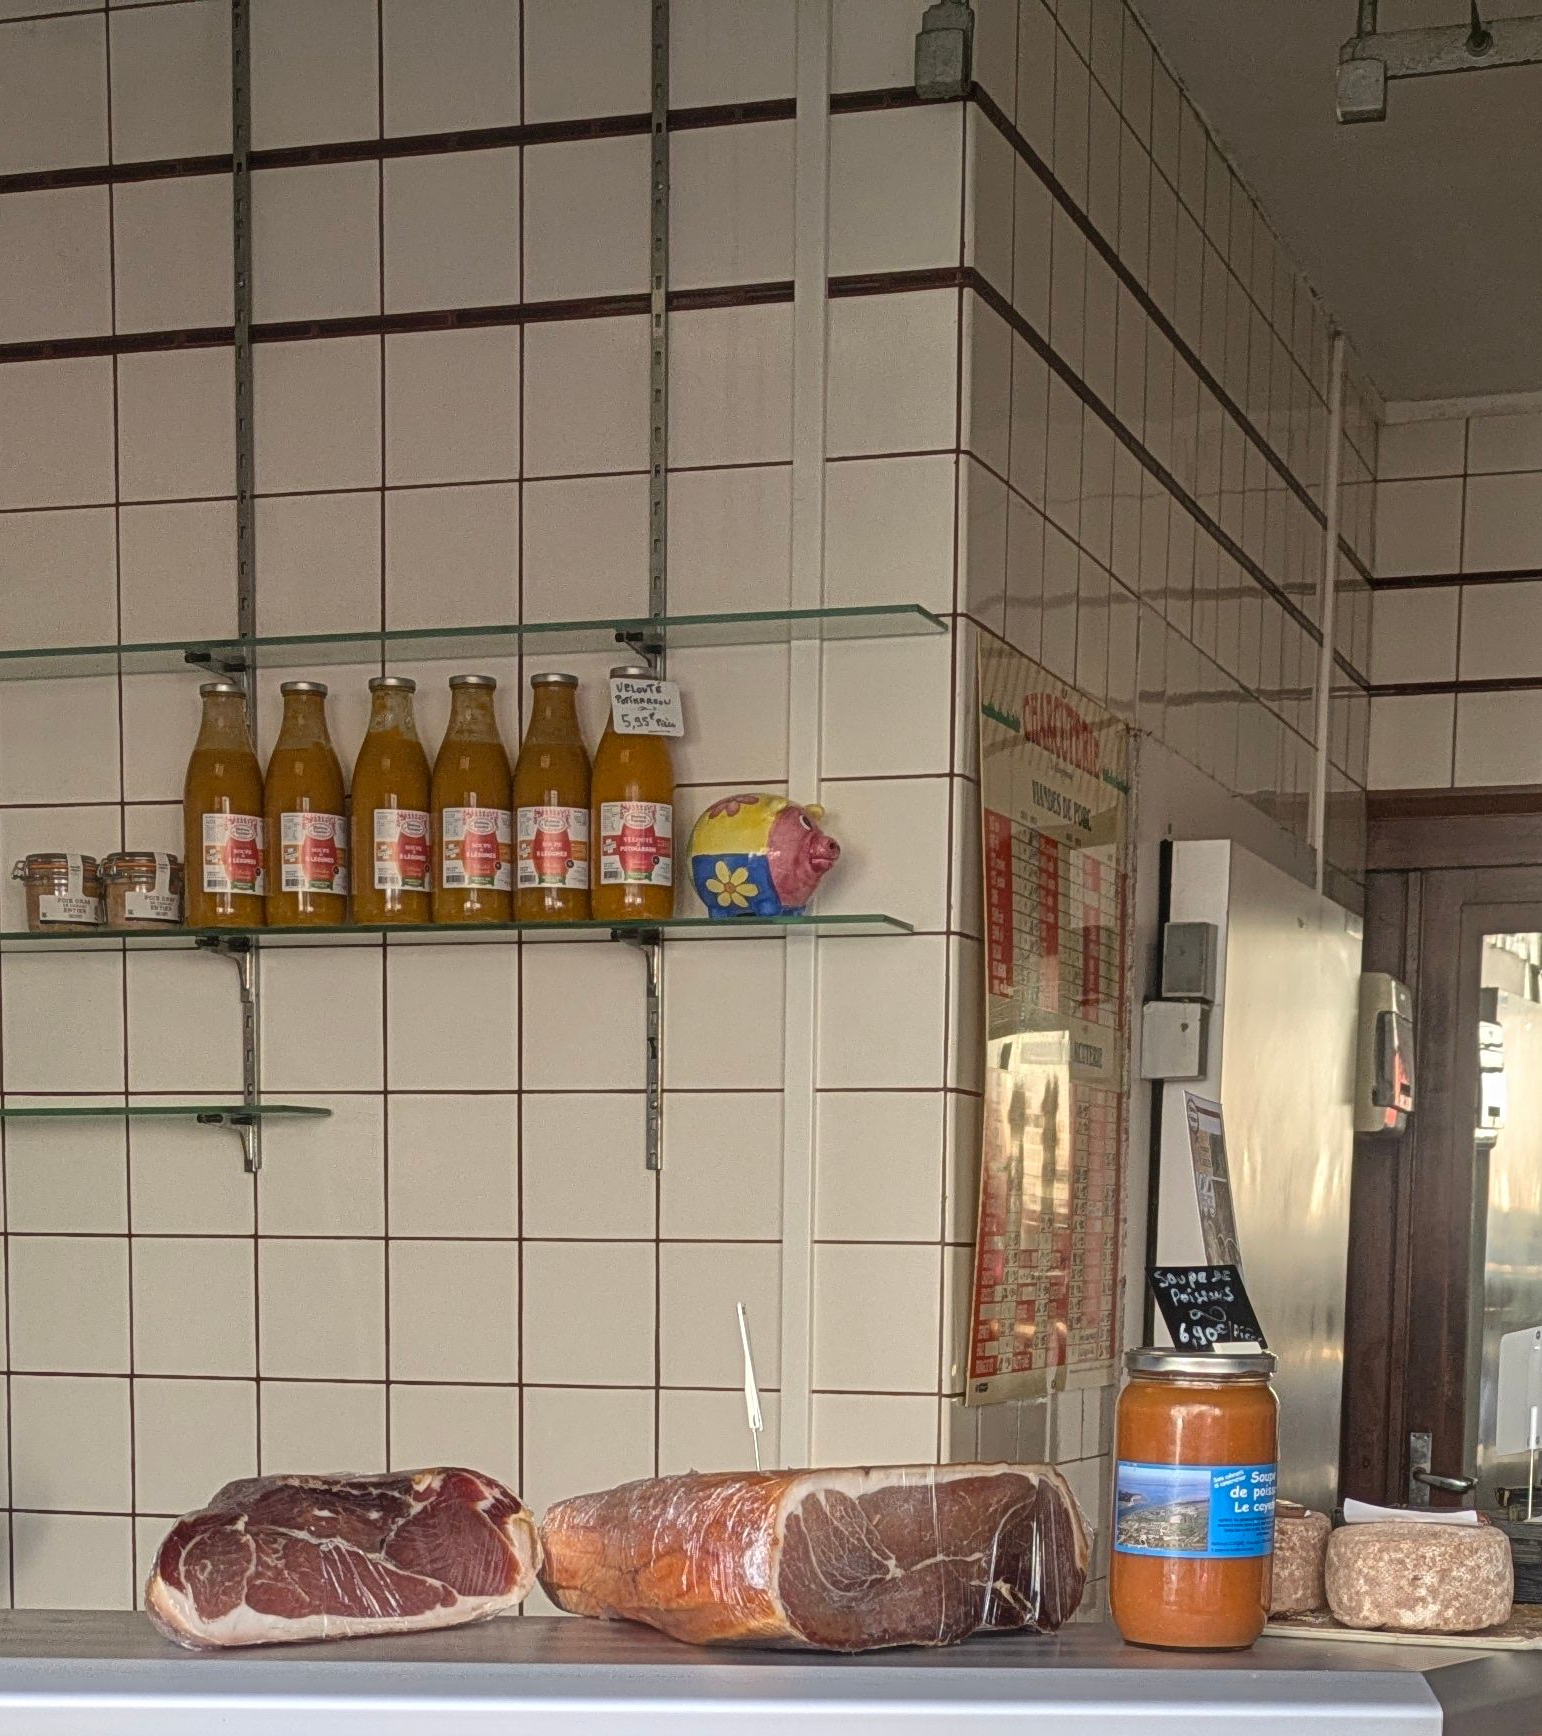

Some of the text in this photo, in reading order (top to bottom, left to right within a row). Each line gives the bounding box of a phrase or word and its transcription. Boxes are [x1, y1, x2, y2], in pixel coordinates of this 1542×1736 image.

[1022, 692, 1100, 780] CHARCUTERIE
[1230, 1485, 1248, 1499] de
[1235, 1501, 1250, 1513] Le
